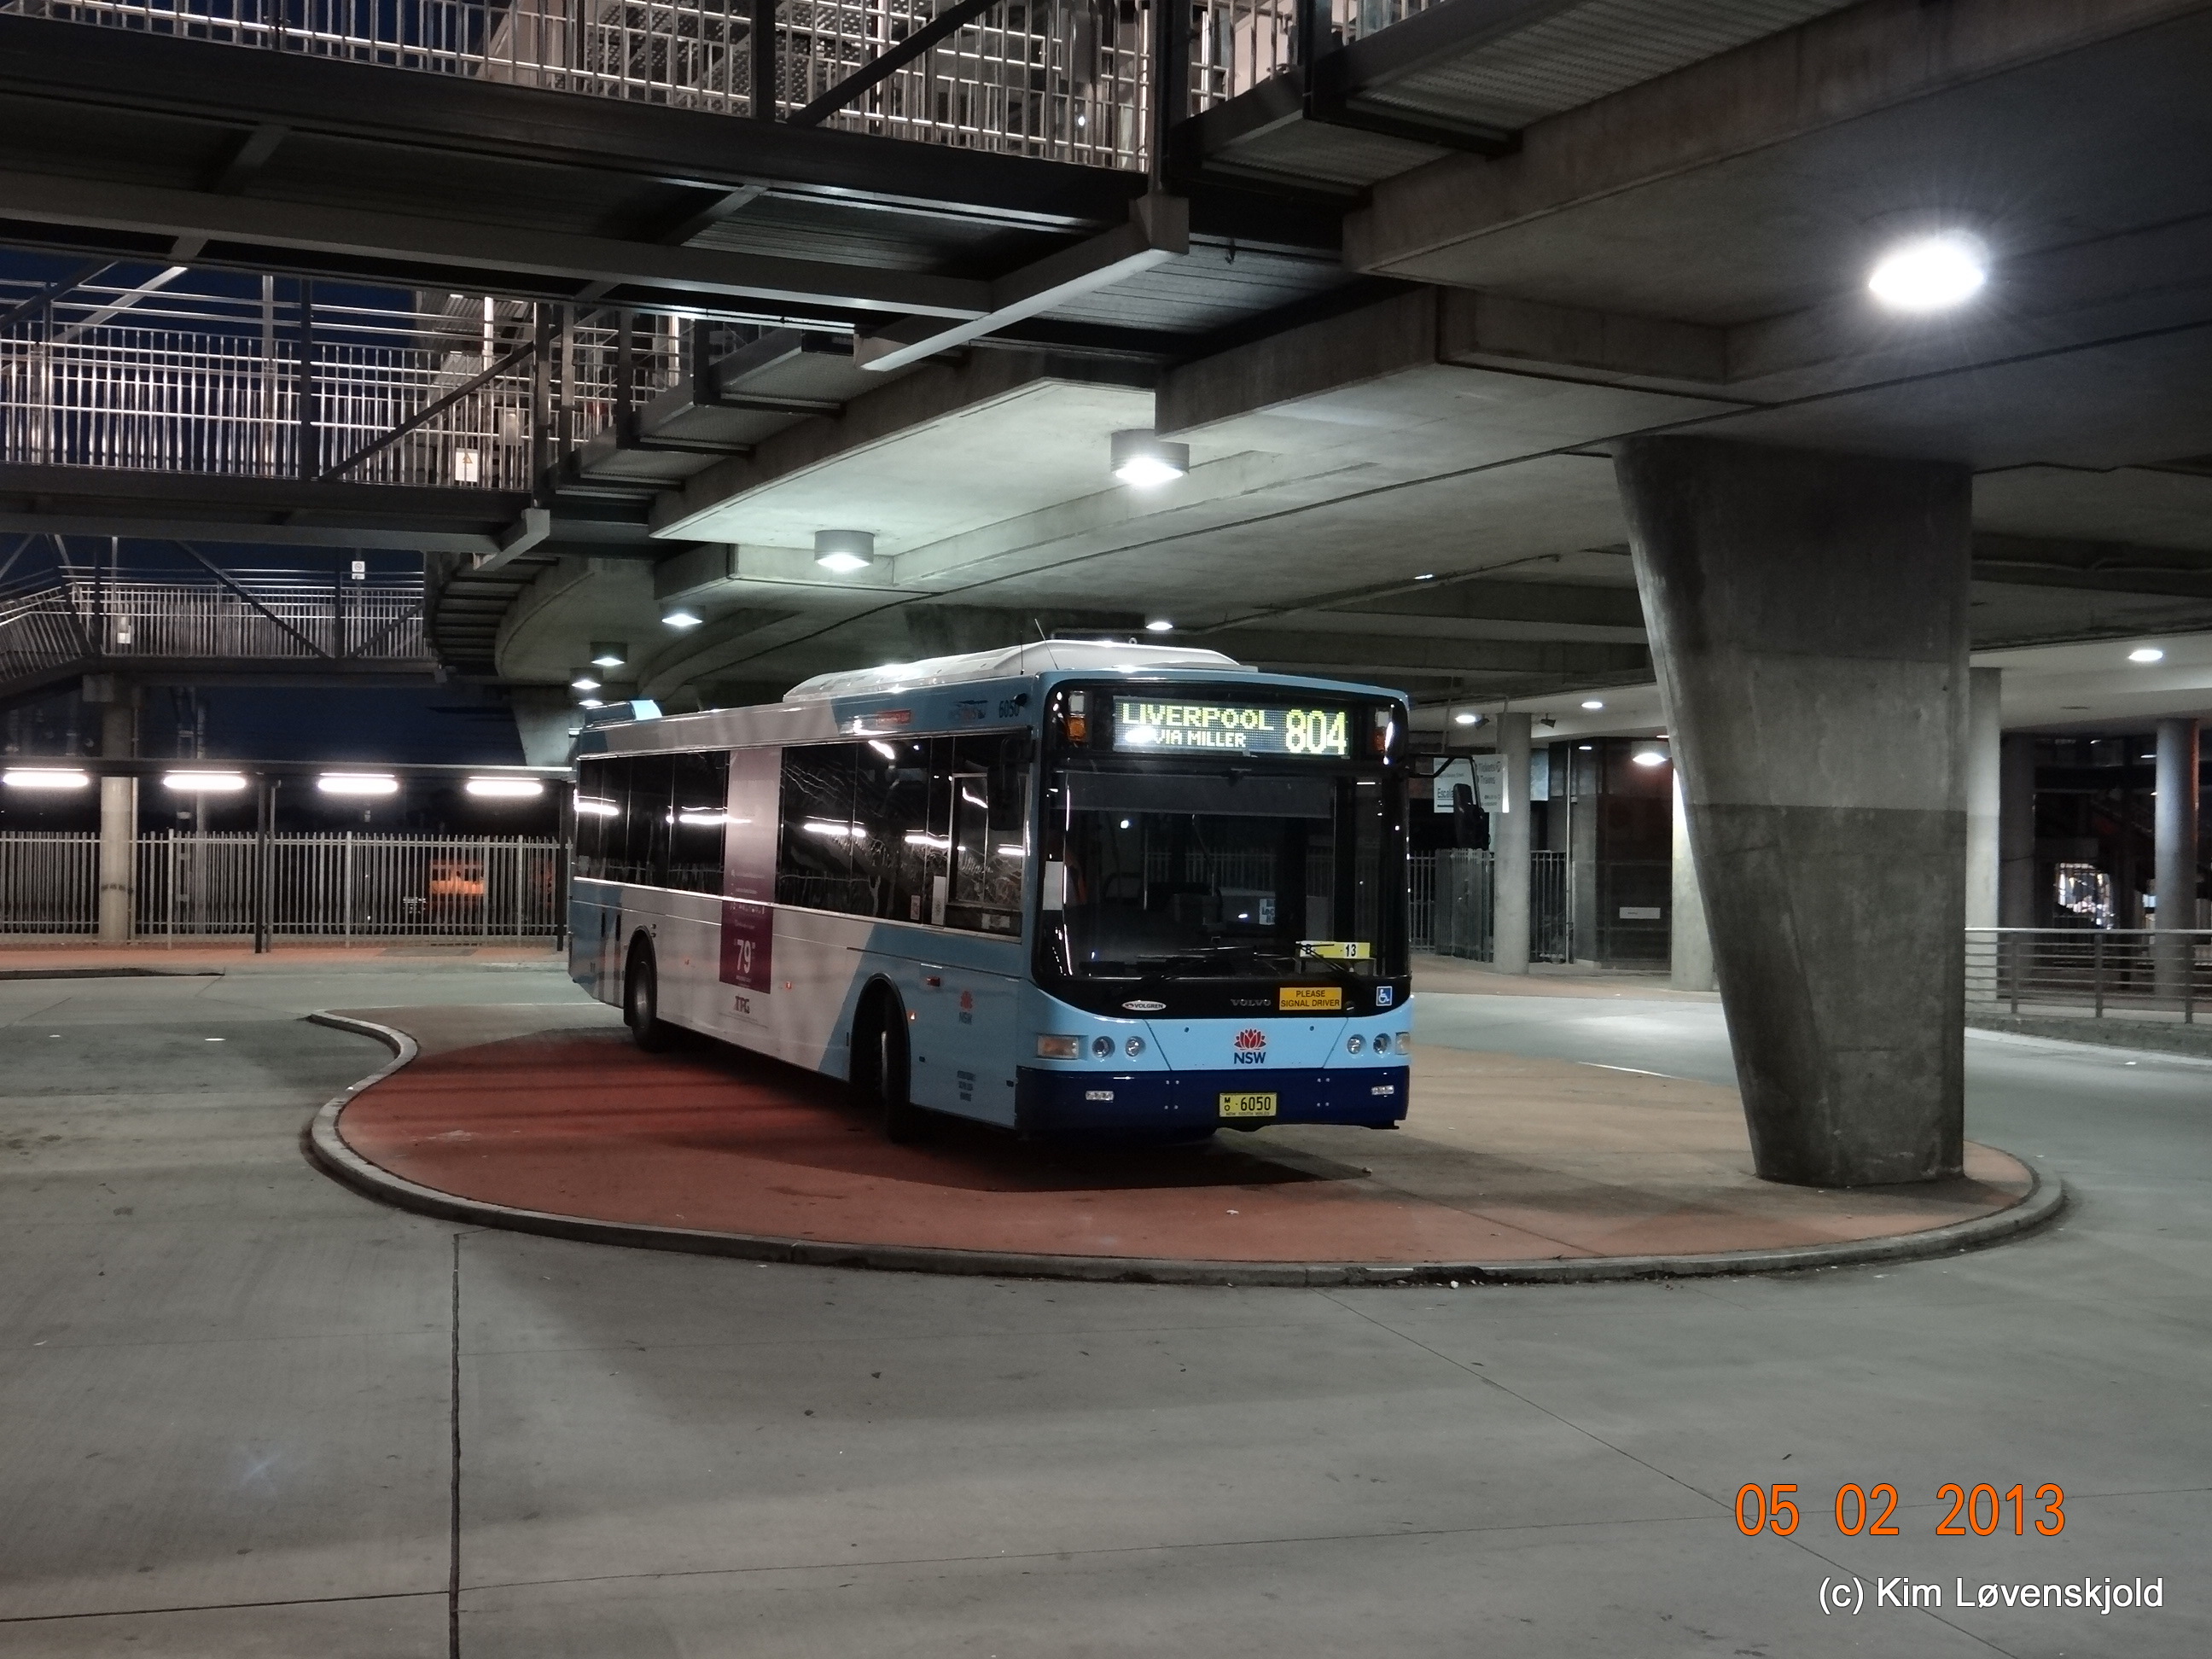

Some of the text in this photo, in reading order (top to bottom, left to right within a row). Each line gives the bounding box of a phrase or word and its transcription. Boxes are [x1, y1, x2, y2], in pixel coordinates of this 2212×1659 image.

[998, 700, 1020, 719] 6050
[1122, 702, 1348, 755] LIVERPOOL 804
[1155, 729, 1247, 748] VIA MILLER
[736, 939, 751, 974] 79
[1345, 944, 1357, 958] 13
[1295, 989, 1326, 998] PLEASE
[1230, 998, 1272, 1007] VOLVO
[1280, 998, 1341, 1008] SIGNAL DRIVER
[1233, 1051, 1266, 1065] NSW
[1240, 1096, 1272, 1111] 6050
